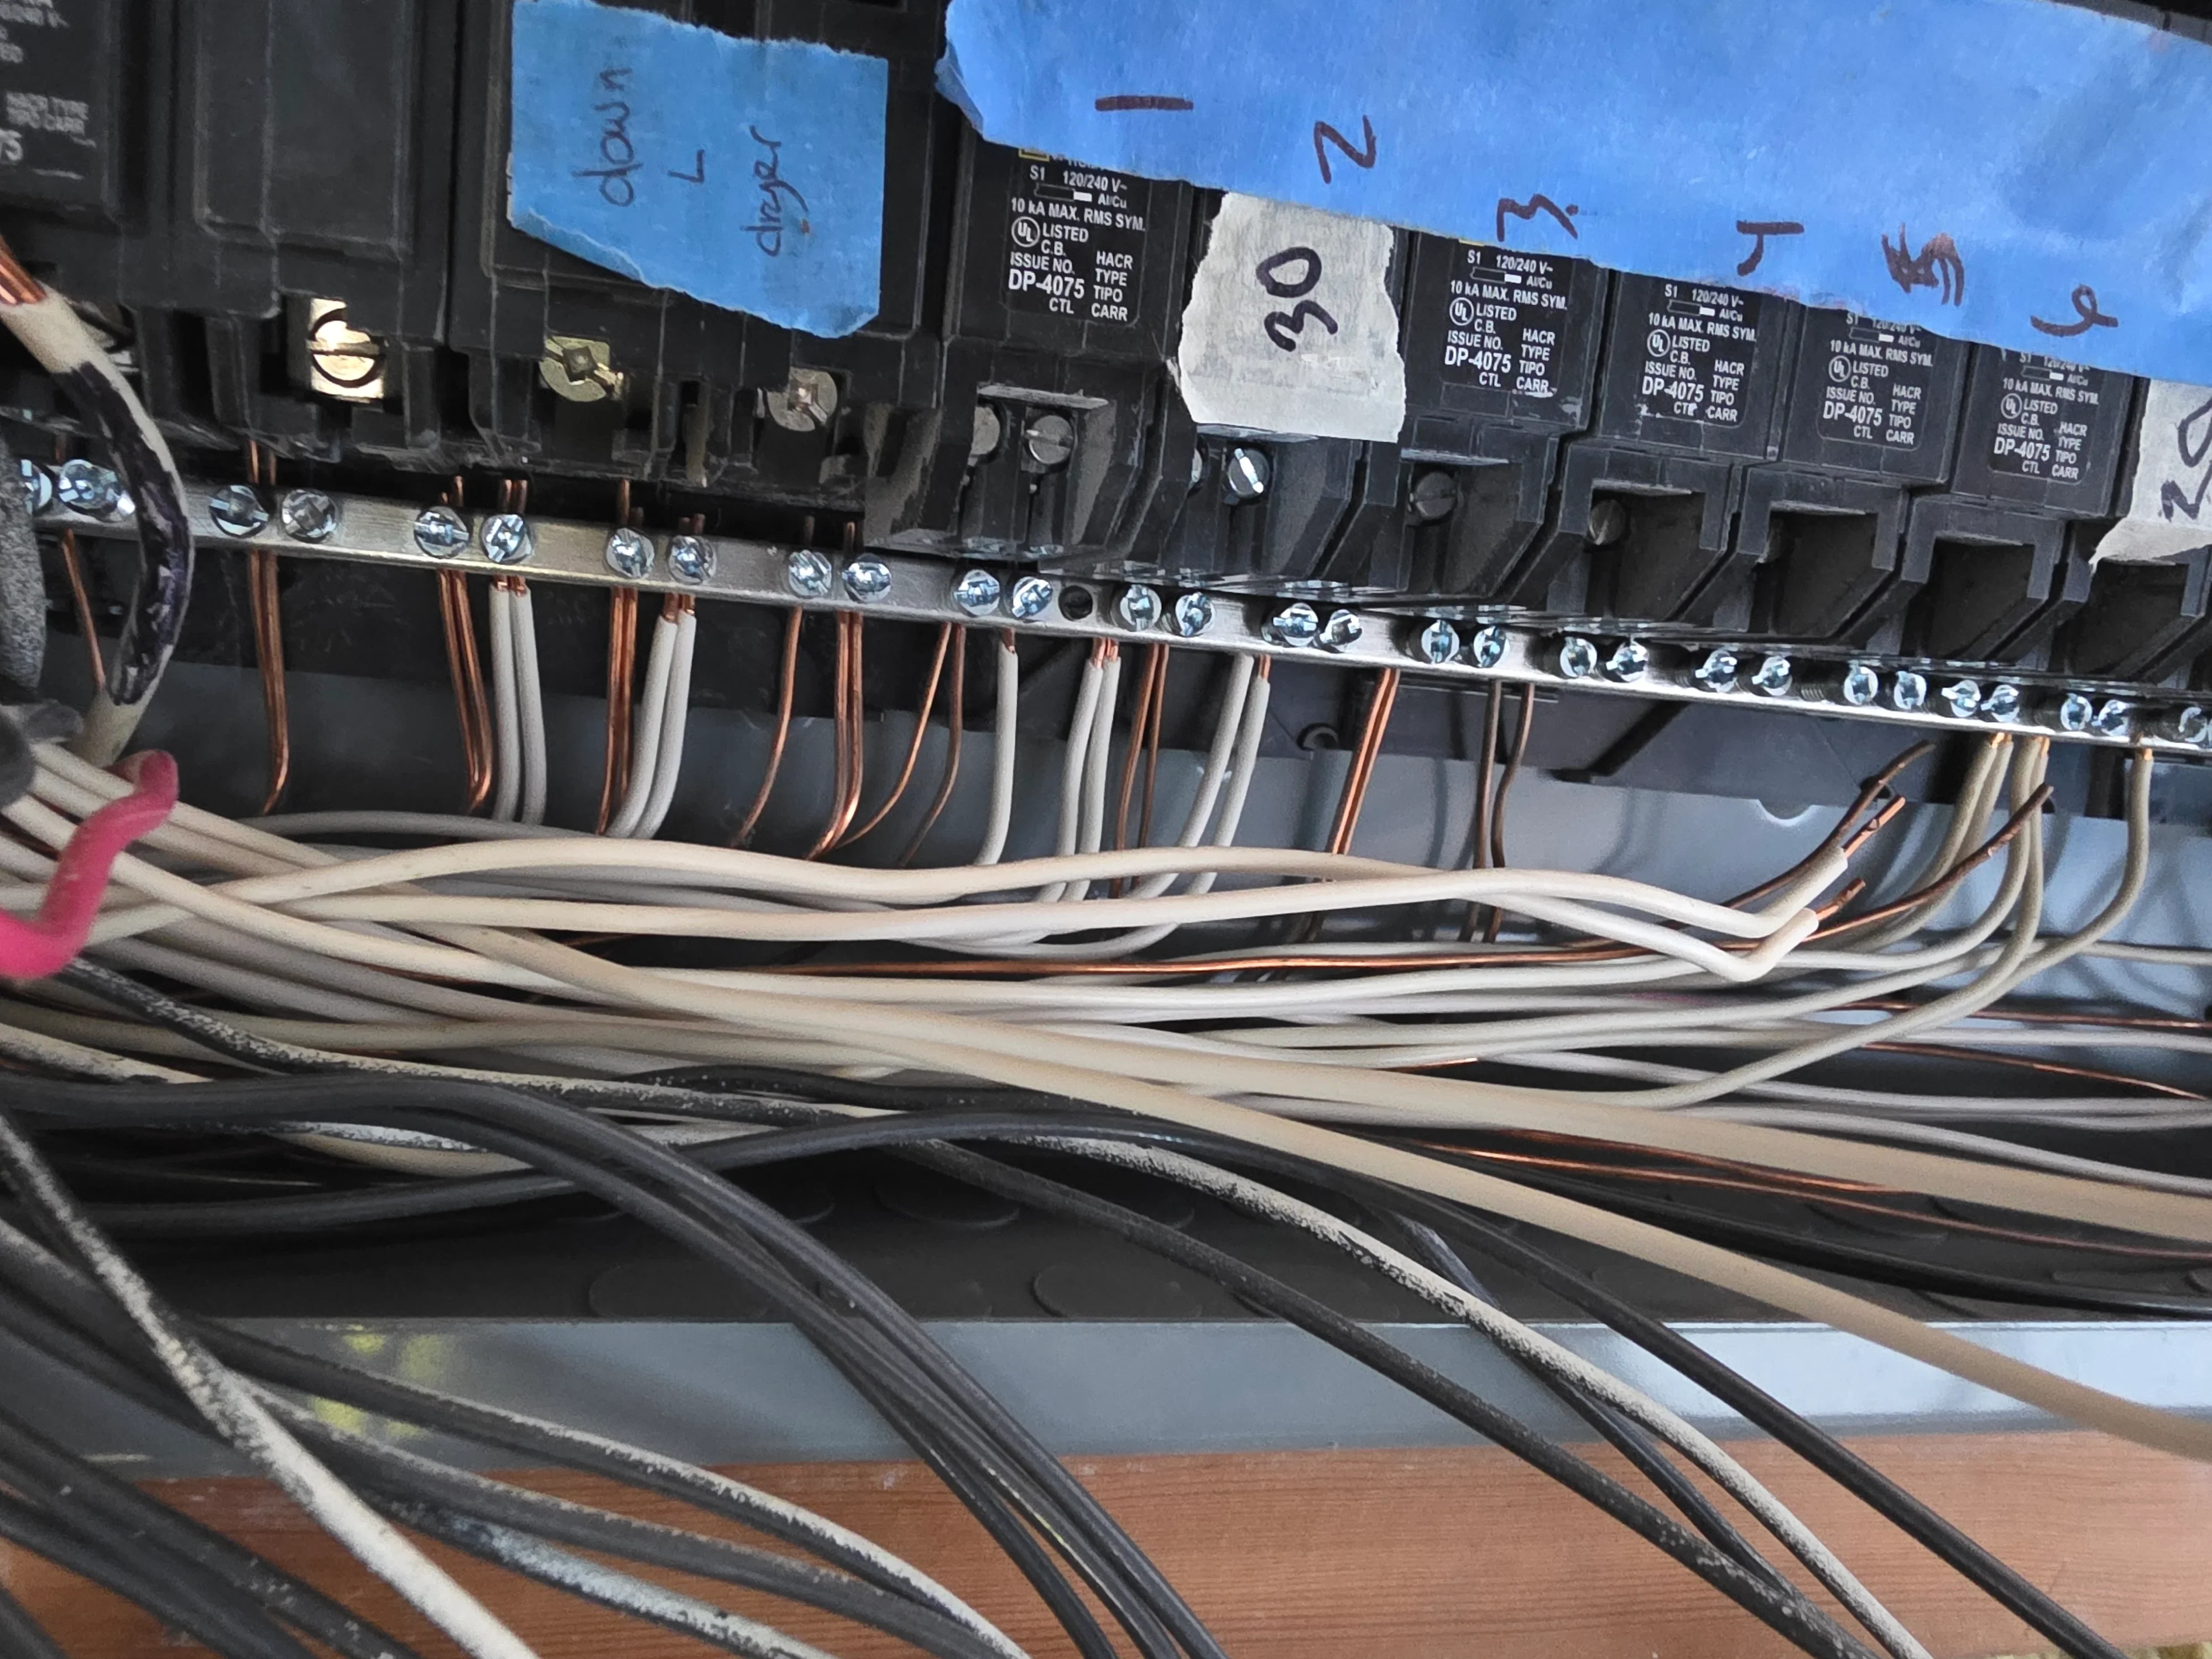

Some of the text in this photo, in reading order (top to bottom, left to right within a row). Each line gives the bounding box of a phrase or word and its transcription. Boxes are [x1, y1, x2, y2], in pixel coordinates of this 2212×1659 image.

[571, 67, 643, 206] down
[667, 149, 704, 183] L
[1030, 165, 1045, 181] S1
[1063, 170, 1108, 191] 120/240
[740, 126, 809, 256] dryer
[1011, 197, 1146, 231] 10 kA MAX. RMS SYM.
[1042, 222, 1089, 243] LISTED
[1041, 239, 1066, 257] C.B.
[1010, 251, 1075, 275] ISSUE NO.
[1096, 251, 1133, 270] HACR
[1467, 250, 1481, 264] S1
[1496, 255, 1536, 273] 120/240
[1008, 268, 1085, 299] DP-4075
[1095, 268, 1128, 286] TYPE
[1093, 285, 1123, 302] TIPO
[1256, 247, 1338, 352] 30
[1451, 280, 1567, 310] 10 kA MAX. RMS SYM.
[1665, 284, 1677, 298] S1
[1692, 288, 1728, 306] 120/240
[1049, 297, 1074, 314] CTL
[1091, 303, 1128, 321] CARR
[1476, 303, 1517, 321] LISTED
[1474, 319, 1496, 334] C.B.
[1648, 312, 1659, 325] 10
[1678, 317, 1704, 333] MAX.
[1707, 322, 1730, 337] RMS
[1732, 326, 1756, 342] SYM.
[1447, 330, 1503, 350] ISSUE NO.
[1523, 328, 1556, 346] HACR
[1672, 335, 1710, 352] LISTED
[1444, 346, 1511, 373] DP-4075
[1521, 344, 1550, 361] TYPE
[1830, 340, 1841, 352] 10
[1886, 348, 1907, 363] RMS
[1519, 360, 1545, 376] TIPO
[1645, 361, 1676, 378] ISSUE
[1714, 359, 1744, 376] HACR
[1853, 361, 1889, 377] LISTED
[1479, 372, 1501, 387] CTL
[1516, 377, 1548, 393] CARR
[1713, 374, 1740, 391] TYPE
[1642, 376, 1704, 402] DP-4075
[1711, 389, 1734, 405] TIPO
[1826, 386, 1856, 402] ISSUE
[1892, 383, 1922, 400] HACR
[1707, 406, 1738, 422] CARR
[1823, 401, 1882, 427] DP-4075
[1891, 399, 1917, 415] TYPE
[2023, 398, 2058, 414] LISTED
[1889, 414, 1911, 429] TIPO
[1854, 425, 1872, 439] CTL
[1886, 430, 1914, 445] CARR
[2058, 436, 2082, 451] TYPE
